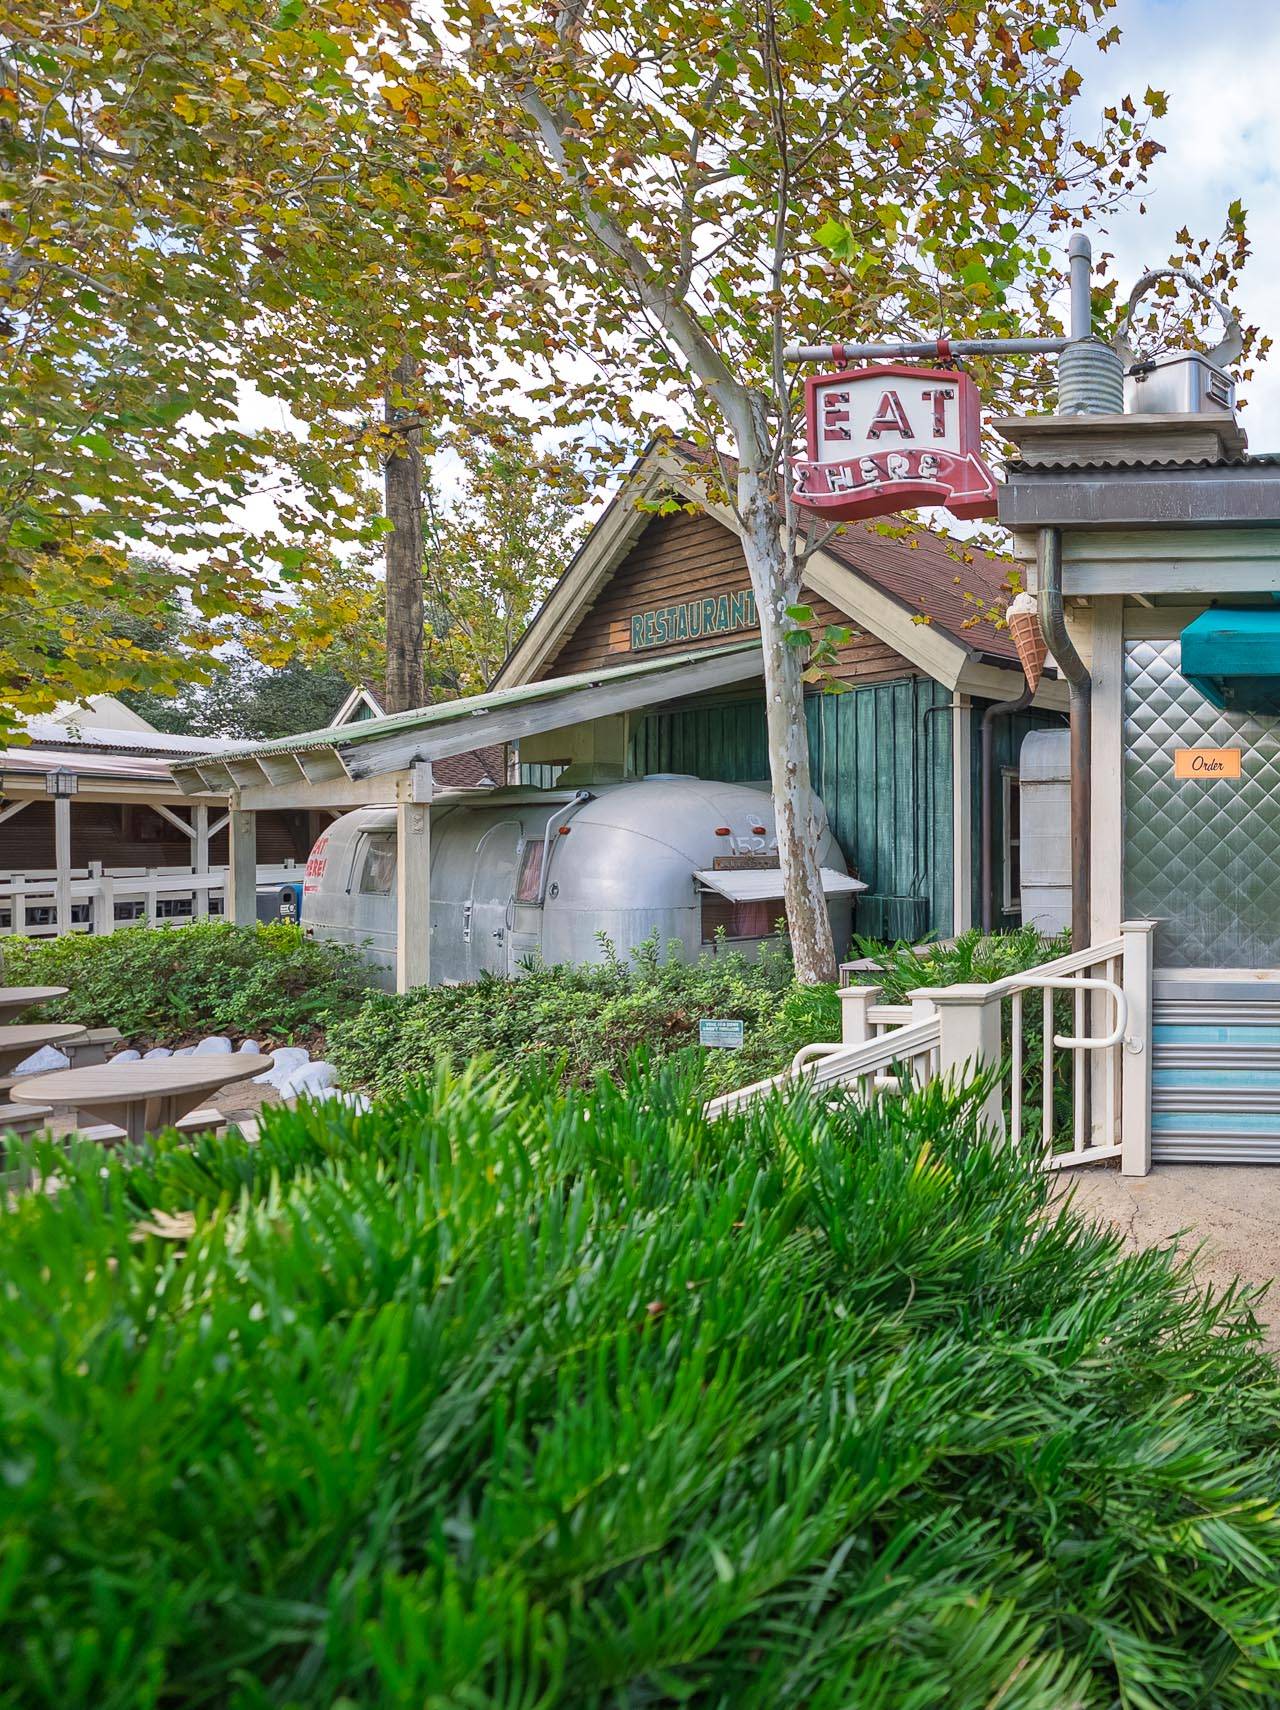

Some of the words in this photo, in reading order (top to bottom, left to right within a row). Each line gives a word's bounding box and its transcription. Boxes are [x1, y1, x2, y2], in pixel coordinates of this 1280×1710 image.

[822, 388, 955, 441] EAT
[825, 453, 940, 493] HERE
[1192, 755, 1225, 771] Order
